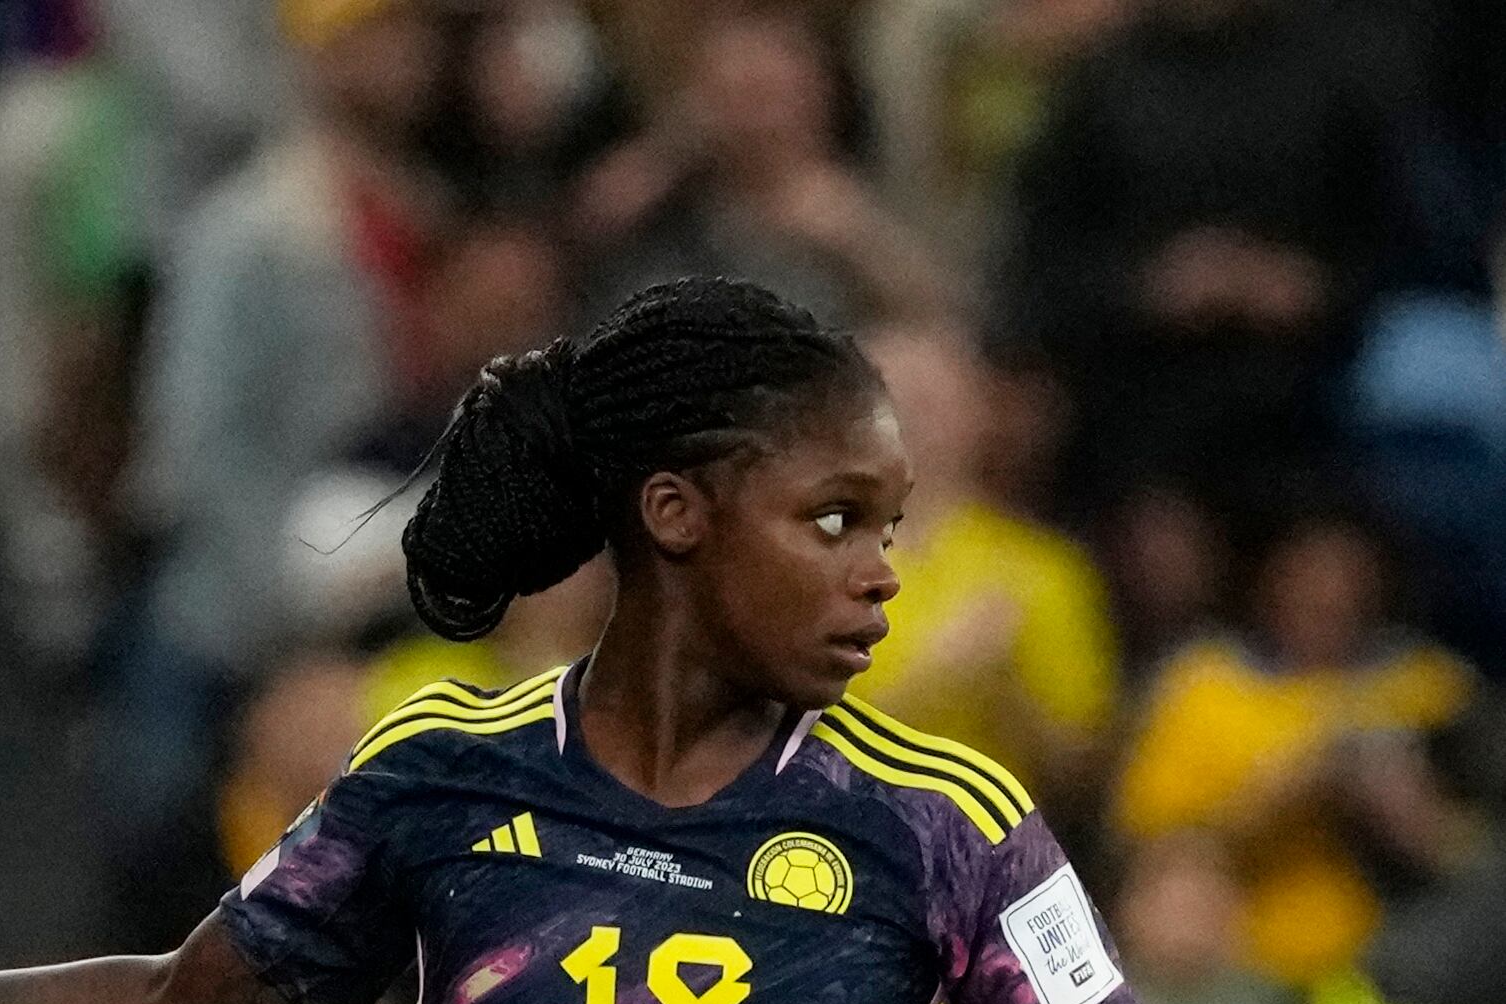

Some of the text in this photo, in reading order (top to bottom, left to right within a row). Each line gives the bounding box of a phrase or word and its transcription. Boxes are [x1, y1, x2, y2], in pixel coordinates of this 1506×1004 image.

[613, 852, 681, 873] 30 JULY 2023
[626, 846, 674, 861] GERMANY
[576, 853, 713, 890] SYDNEY FOOTBALL STADIUM
[1026, 901, 1071, 935] FOOTB
[1045, 954, 1068, 976] the
